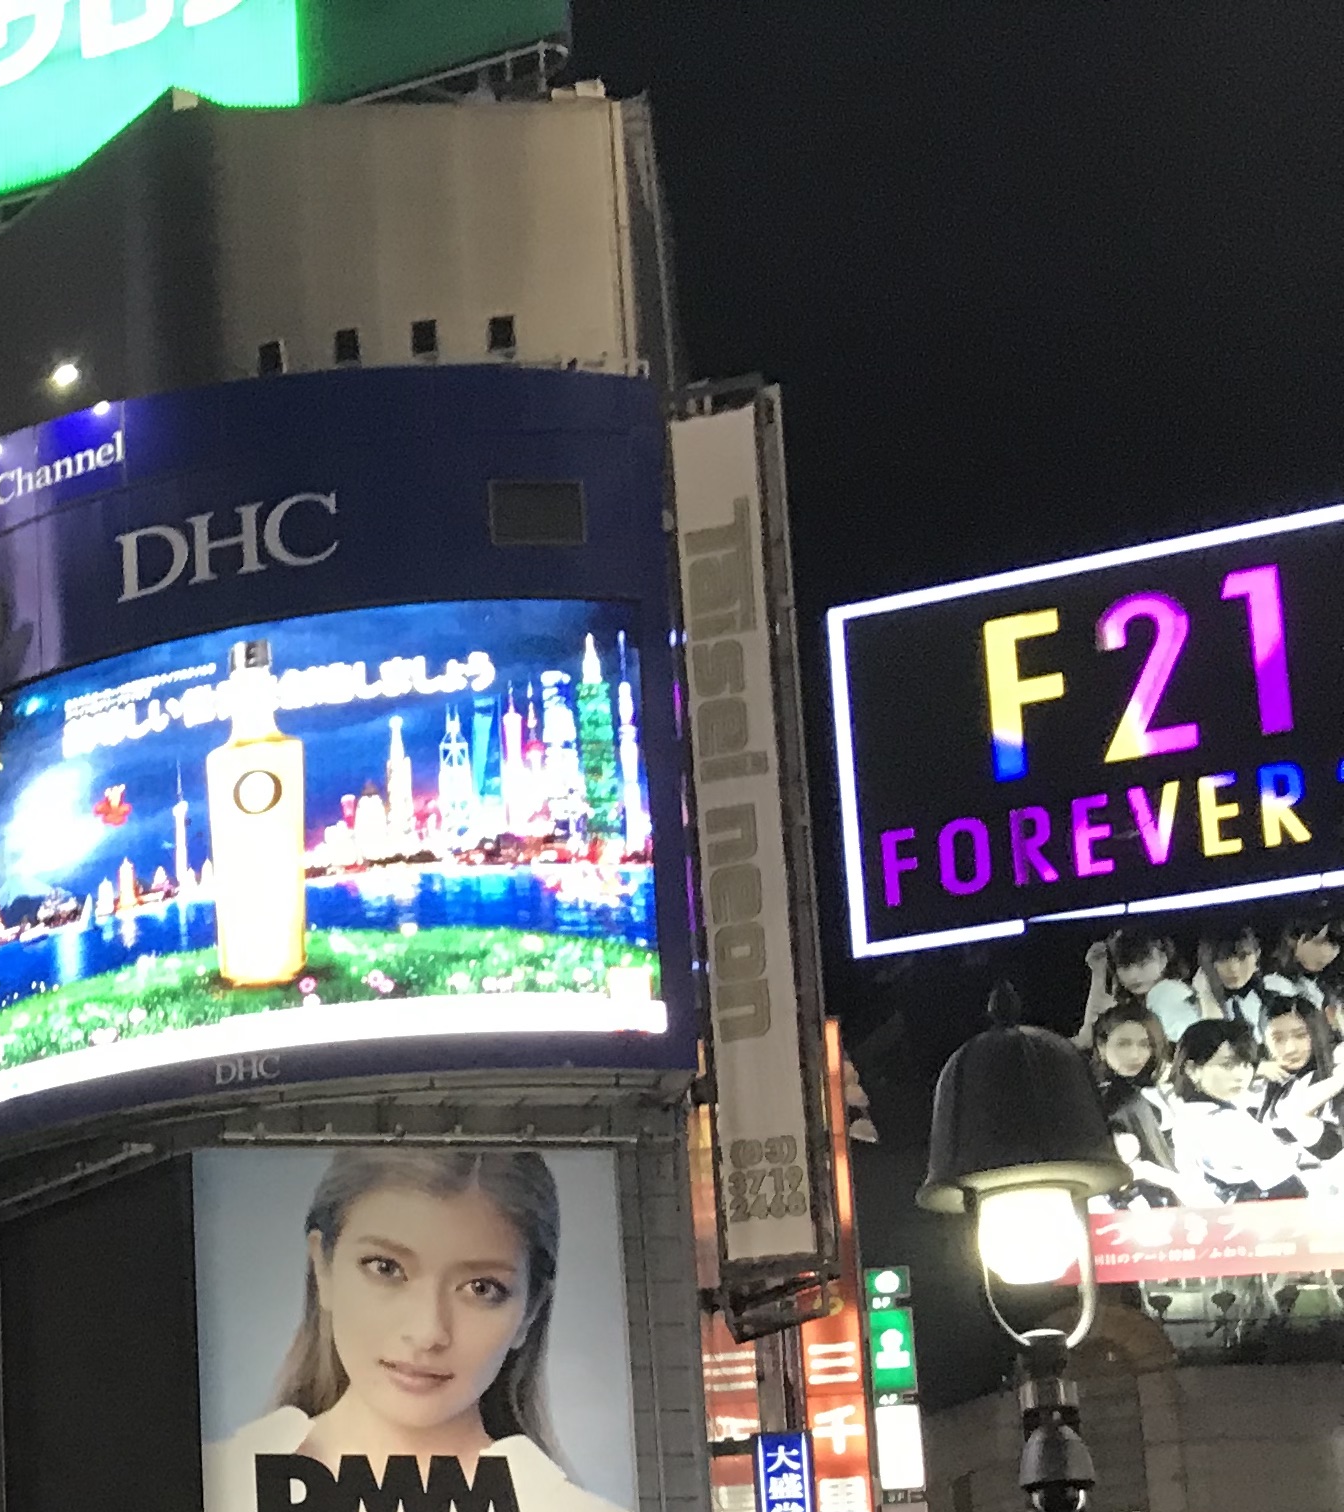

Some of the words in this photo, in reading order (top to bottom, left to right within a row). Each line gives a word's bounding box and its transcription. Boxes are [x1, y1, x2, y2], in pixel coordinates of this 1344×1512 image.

[114, 491, 340, 603] DHC
[684, 496, 769, 783] Taisei
[880, 762, 1313, 908] FOREVER
[705, 803, 771, 1043] neon
[214, 1054, 281, 1086] DHC
[728, 1165, 804, 1197] 3719
